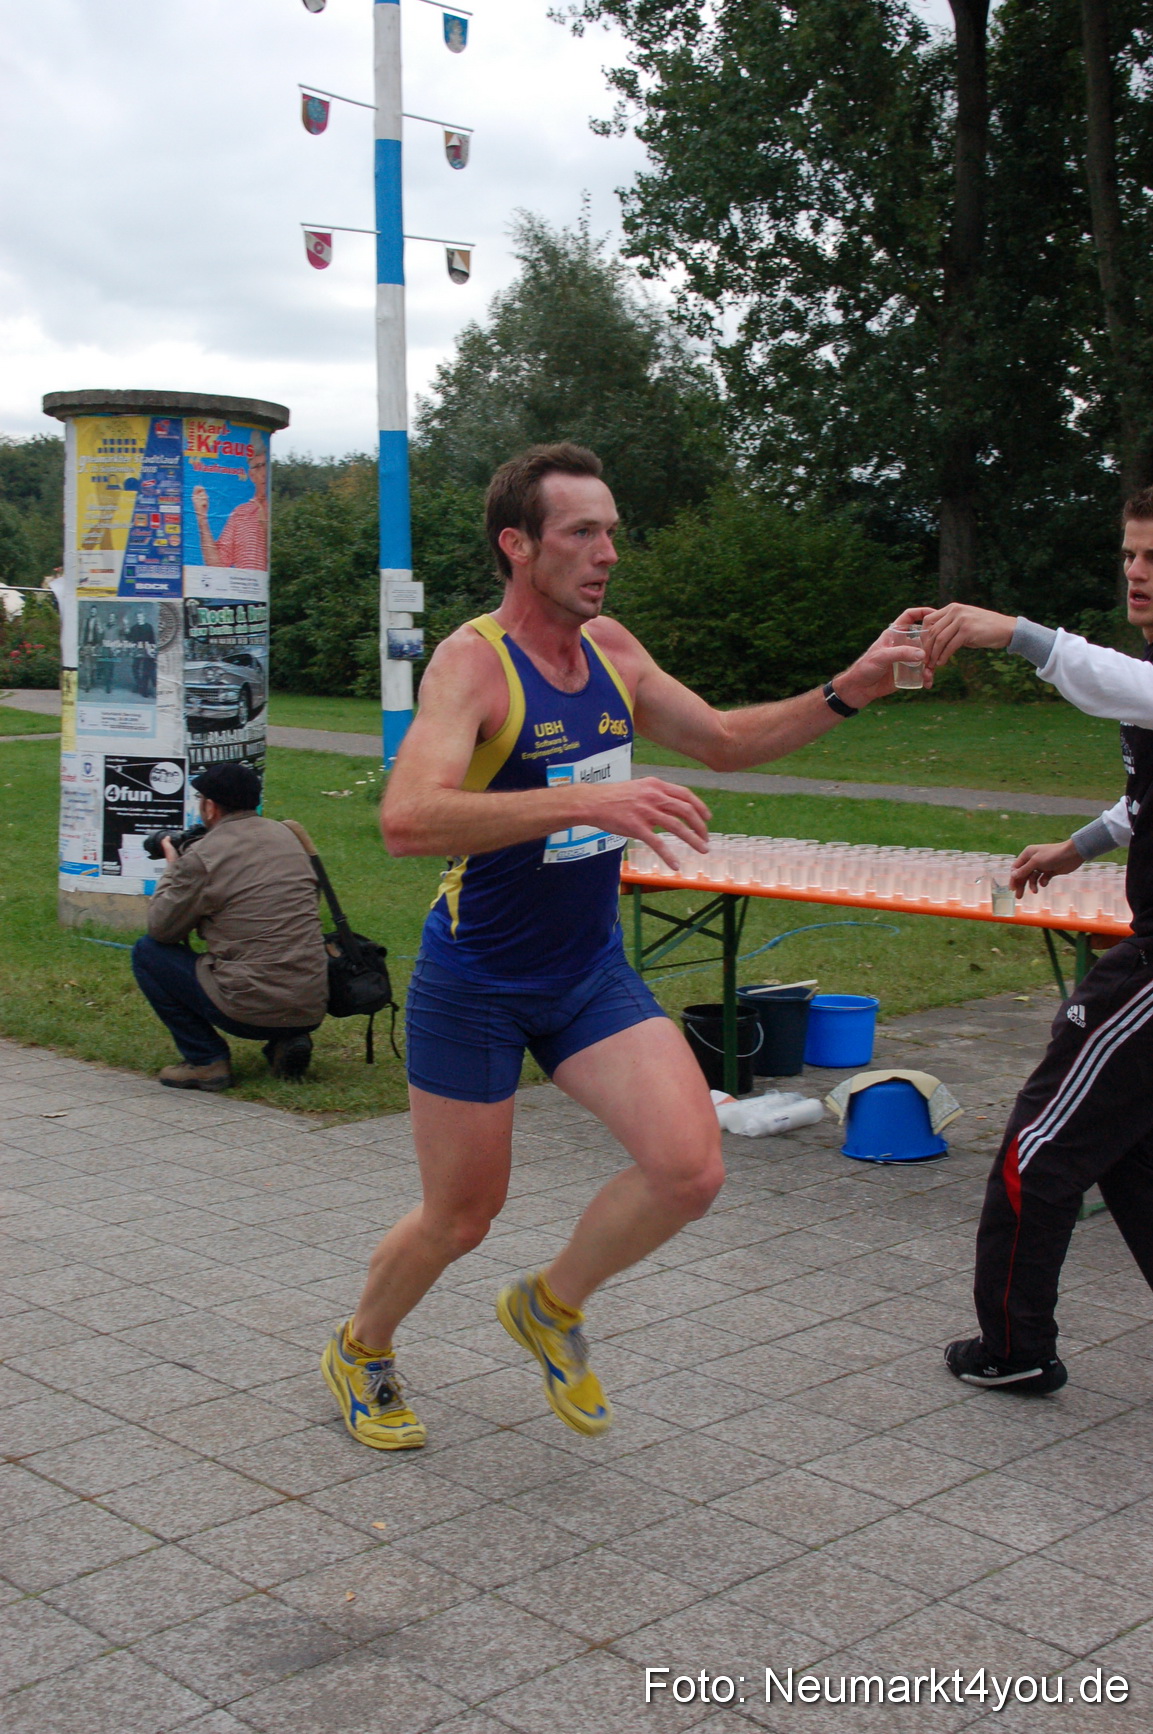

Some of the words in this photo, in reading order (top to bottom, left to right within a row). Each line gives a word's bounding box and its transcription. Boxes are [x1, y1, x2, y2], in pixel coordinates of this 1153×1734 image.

[197, 434, 255, 458] Kraus
[197, 607, 235, 626] Rock
[236, 605, 247, 623] &
[534, 720, 564, 738] UBH
[535, 738, 561, 749] Software
[522, 746, 563, 760] Engineering
[580, 763, 611, 783] Helmut
[105, 784, 153, 802] 4fun
